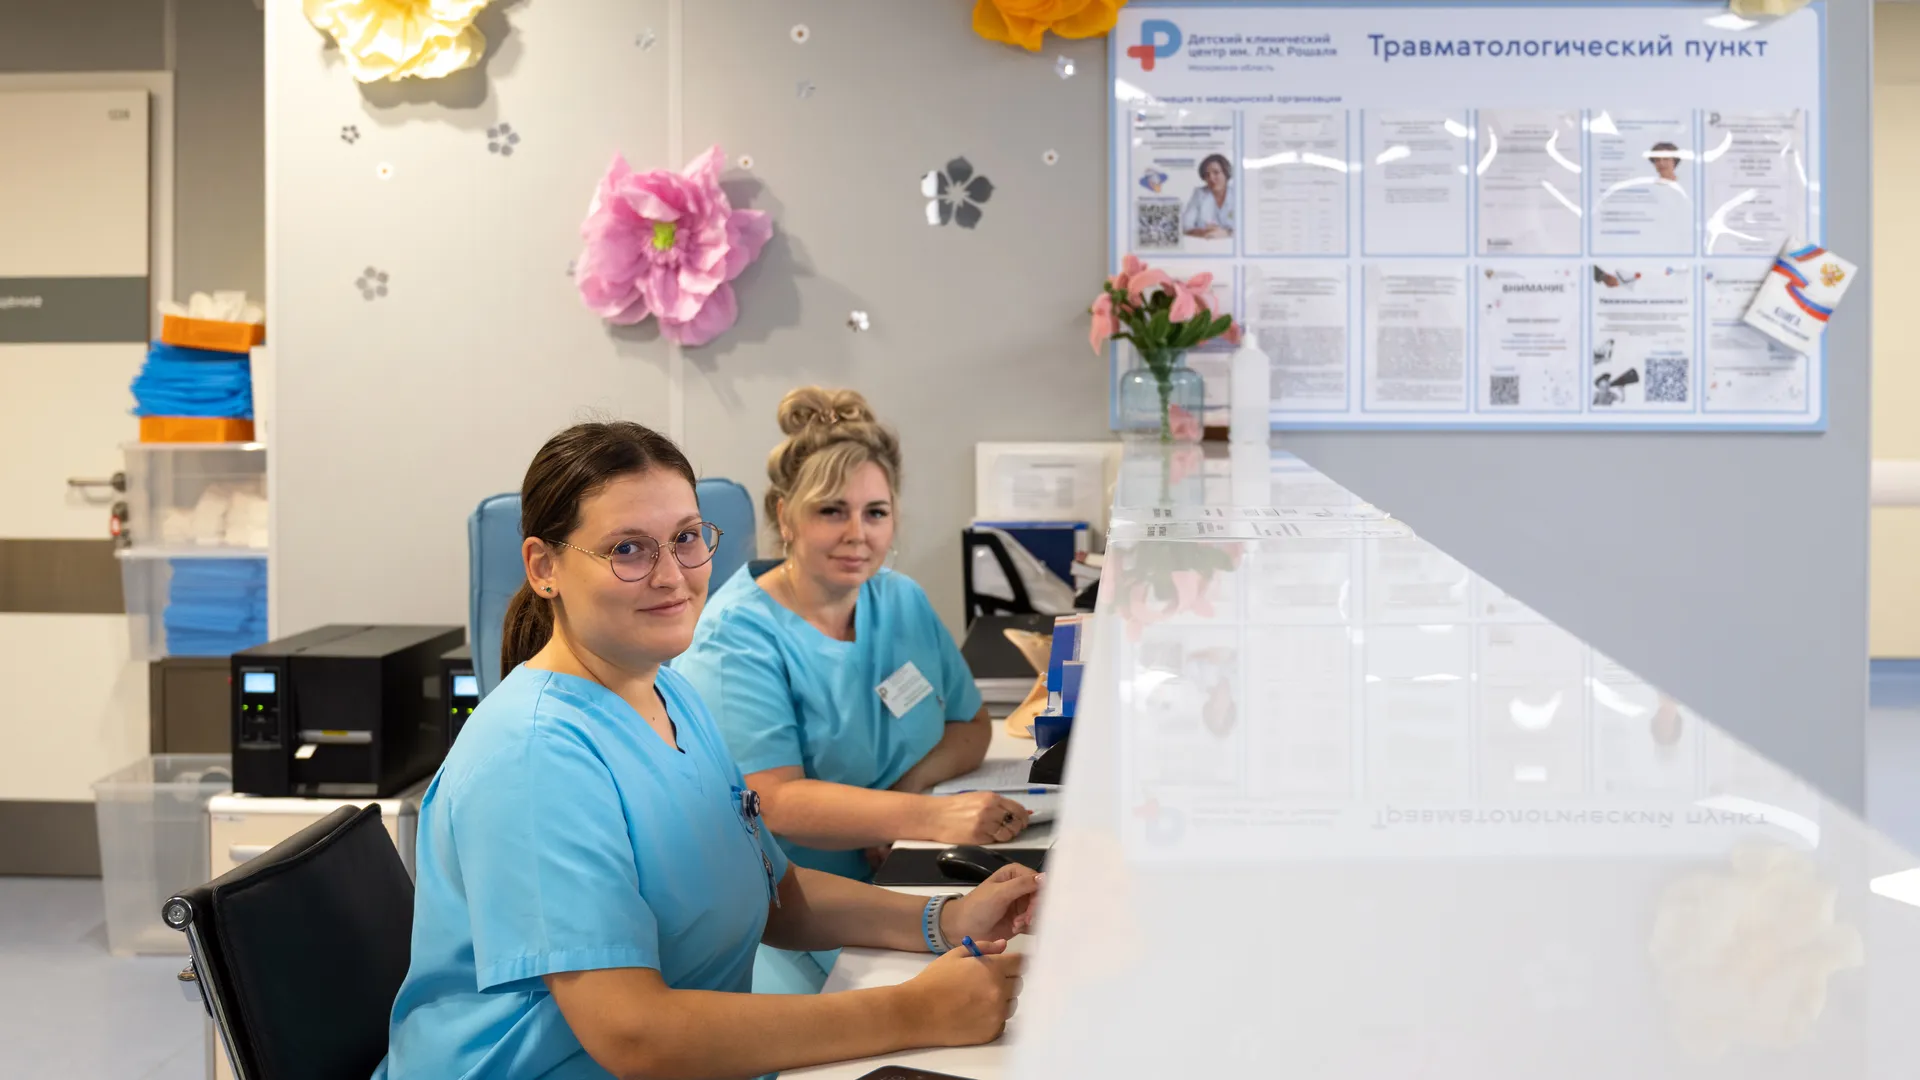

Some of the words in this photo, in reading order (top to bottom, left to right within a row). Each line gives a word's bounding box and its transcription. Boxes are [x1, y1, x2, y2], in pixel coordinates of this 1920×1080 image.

[1187, 33, 1242, 45] Детский
[1246, 33, 1330, 45] клинический
[1188, 47, 1226, 58] центр
[1368, 33, 1673, 62] Травматологический
[1684, 39, 1768, 62] пункт
[1501, 283, 1565, 294] ВНИМАНИЕ
